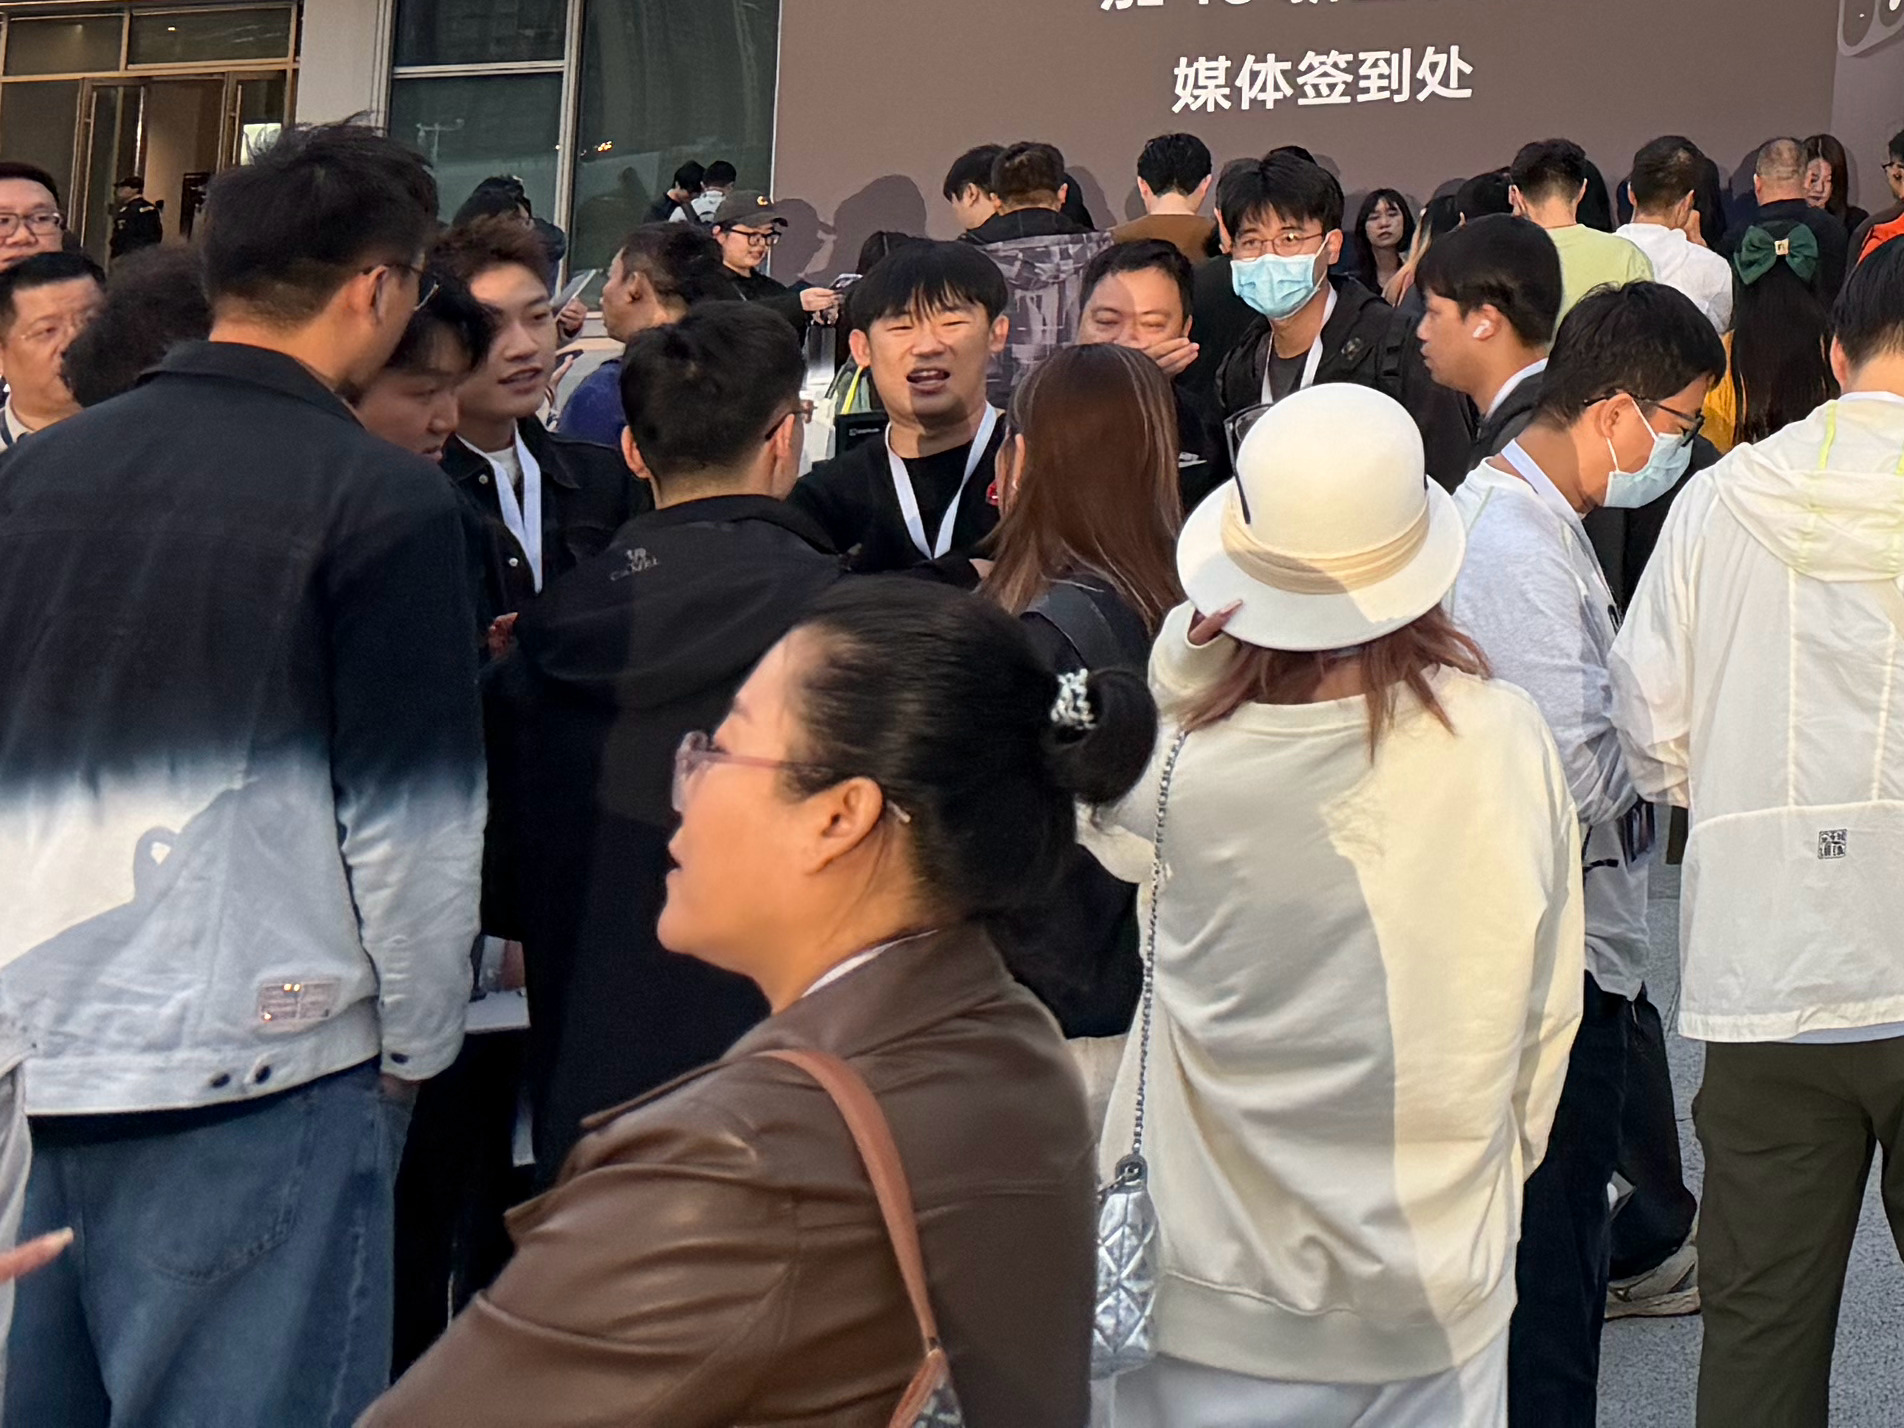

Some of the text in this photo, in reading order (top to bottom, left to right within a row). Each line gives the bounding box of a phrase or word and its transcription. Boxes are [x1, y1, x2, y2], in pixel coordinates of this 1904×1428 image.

[1171, 45, 1474, 114] 媒体签到处
